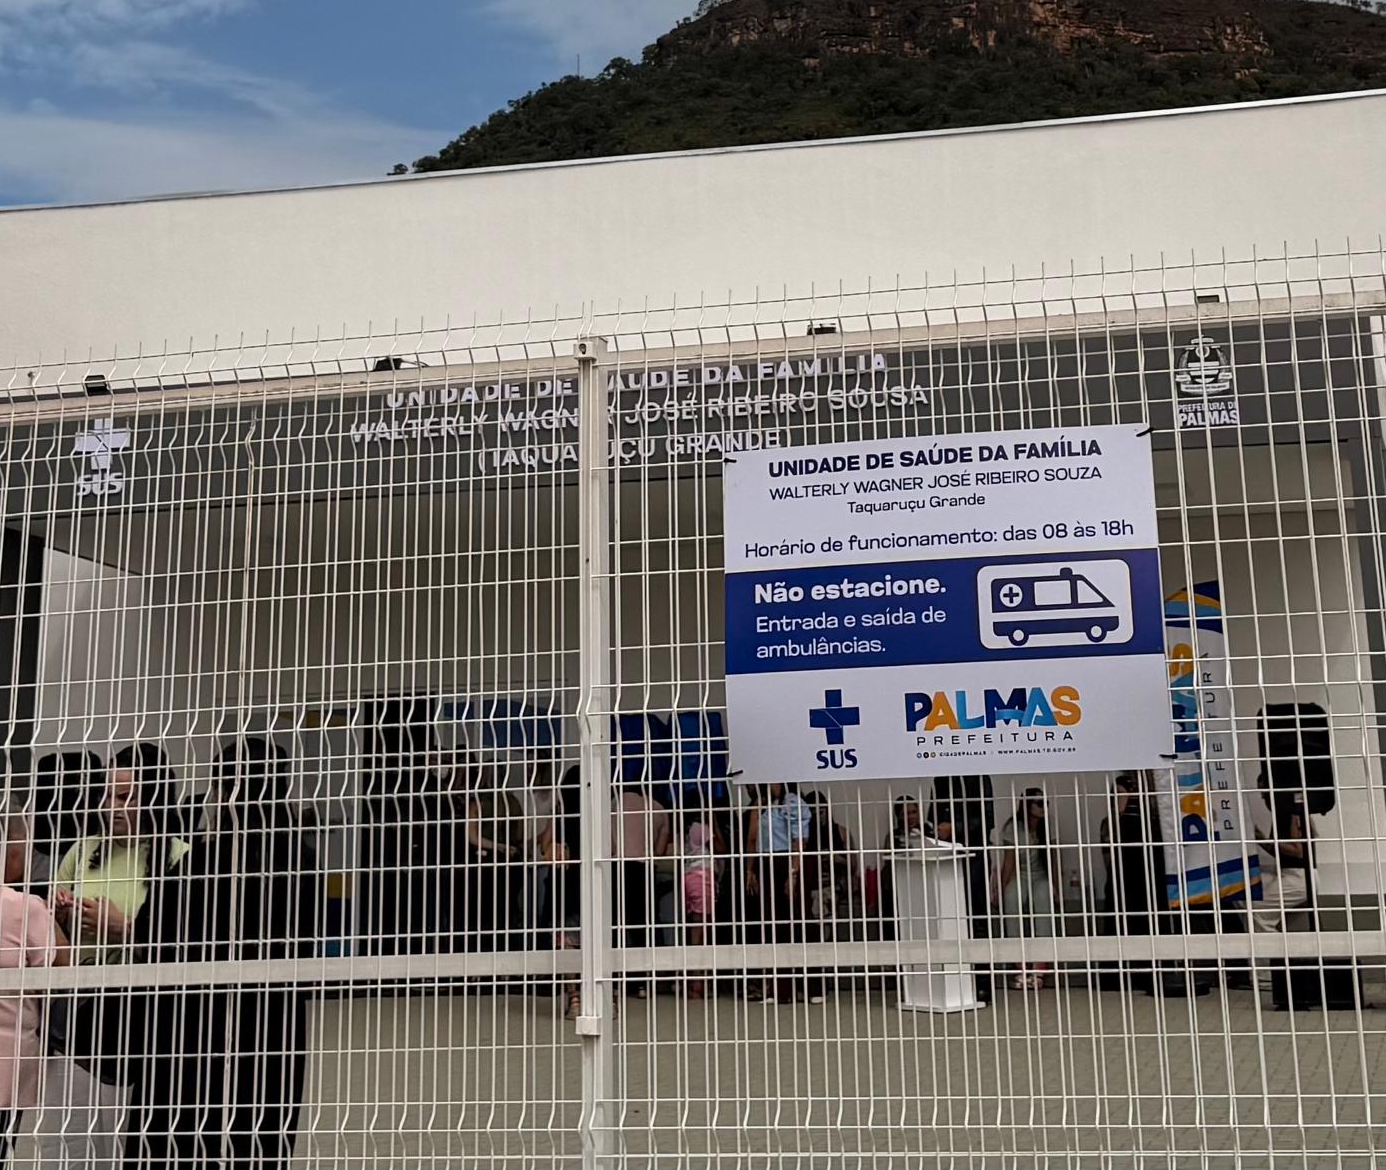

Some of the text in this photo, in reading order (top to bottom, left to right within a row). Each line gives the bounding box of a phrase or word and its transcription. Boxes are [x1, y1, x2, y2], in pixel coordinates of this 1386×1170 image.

[535, 377, 573, 397] DE
[702, 365, 745, 384] DA
[498, 406, 615, 433] WAGN
[1178, 410, 1239, 428] PALMAS
[477, 437, 656, 476] (TAQUAÇU
[768, 434, 1102, 478] UNIDADE DE SAÚDE DA FAMÍLIA
[76, 471, 125, 497] SUS
[769, 466, 1103, 501] WALTERLY WAGNER JOSÉ RIBEIRO SOUZA
[847, 492, 986, 516] Taquaruçu Grande
[744, 519, 1134, 559] Horário de funcionamento: das 08 às 18h
[754, 573, 947, 605] Não estacione.
[755, 605, 947, 634] Entrada e saída de
[755, 636, 887, 659] ambulâncias.
[904, 685, 1082, 733] PALMAS
[916, 731, 1074, 747] PREFEITURA
[1201, 652, 1234, 832] PREFETUR
[815, 748, 859, 770] SUS
